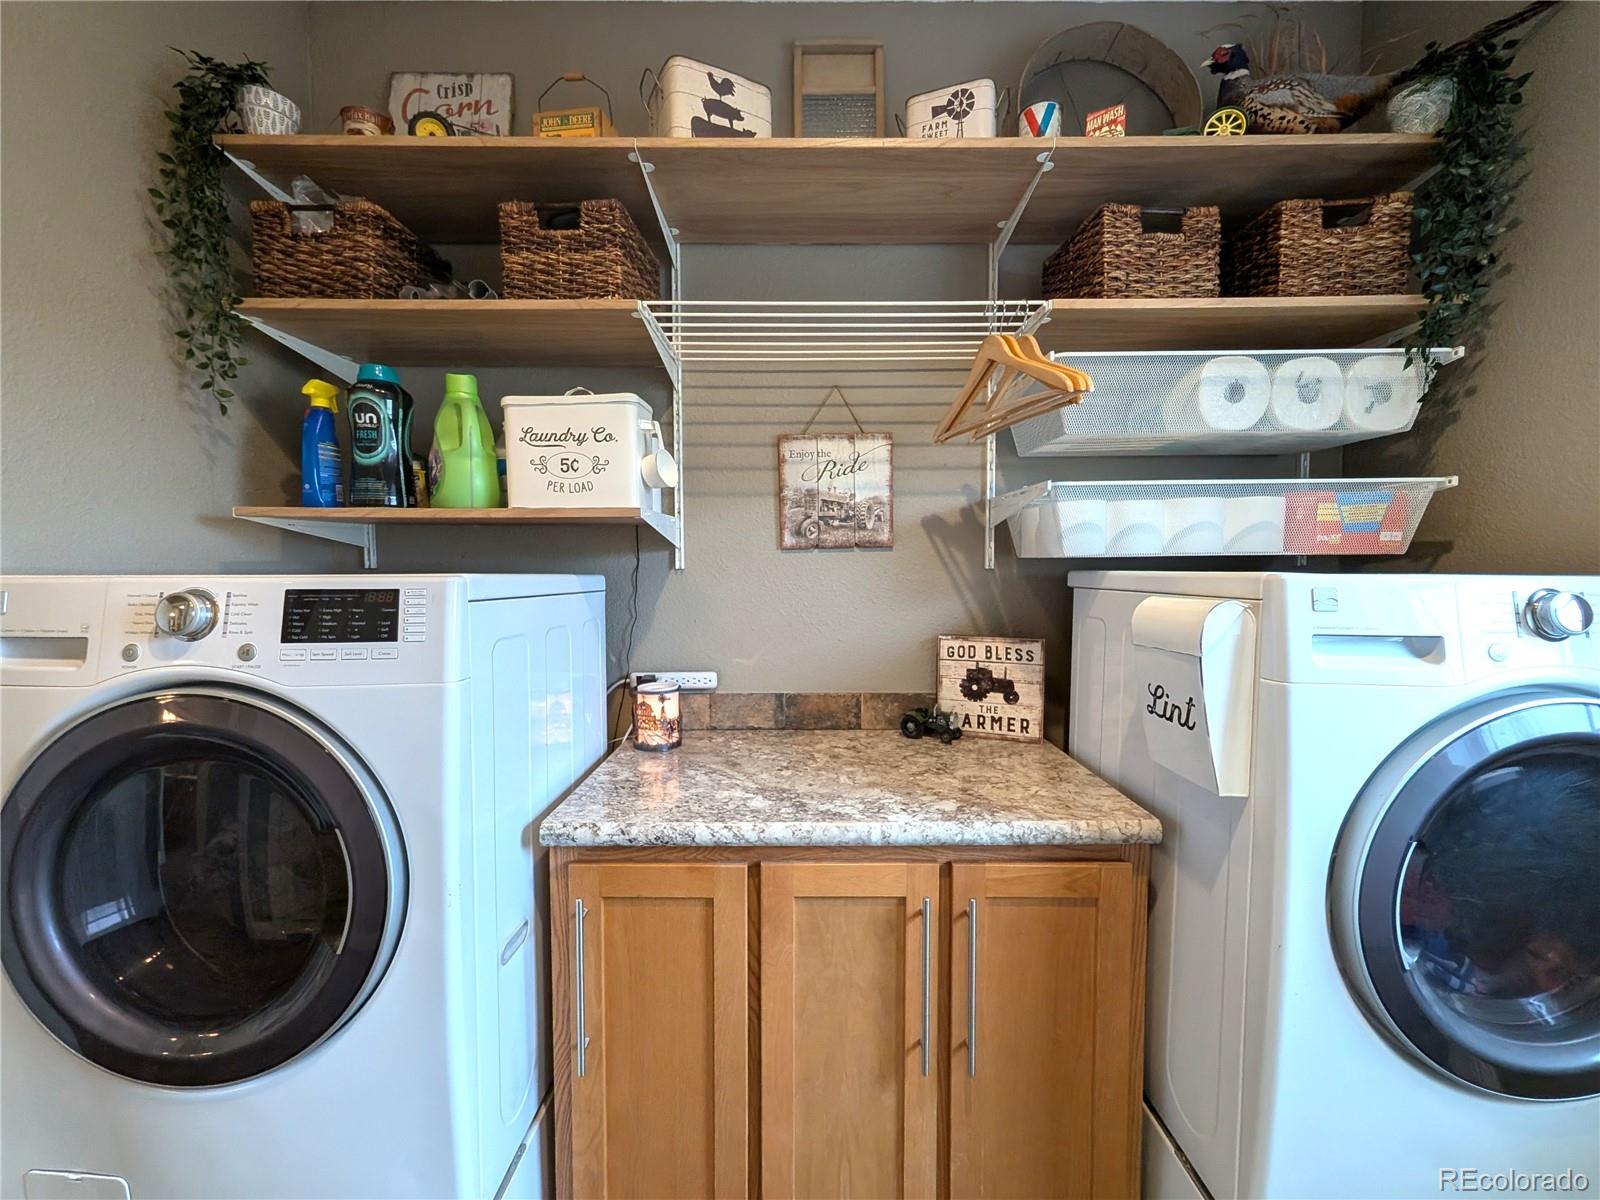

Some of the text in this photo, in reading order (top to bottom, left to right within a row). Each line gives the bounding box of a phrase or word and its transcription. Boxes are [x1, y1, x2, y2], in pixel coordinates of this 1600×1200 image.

[541, 116, 562, 128] JOHN
[569, 113, 593, 125] DEERE
[1102, 103, 1125, 124] WASH
[921, 119, 949, 134] FARM
[356, 429, 378, 439] FRESH
[518, 426, 619, 449] Laundry Co.
[789, 448, 832, 461] Enjoy the
[560, 457, 580, 474] 5¢
[801, 449, 876, 483] Ride
[546, 480, 594, 494] PER LOAD
[946, 645, 1035, 662] GOD BLESS
[979, 704, 999, 715] THE
[1146, 682, 1196, 731] Lint
[961, 713, 1031, 735] ARMER
